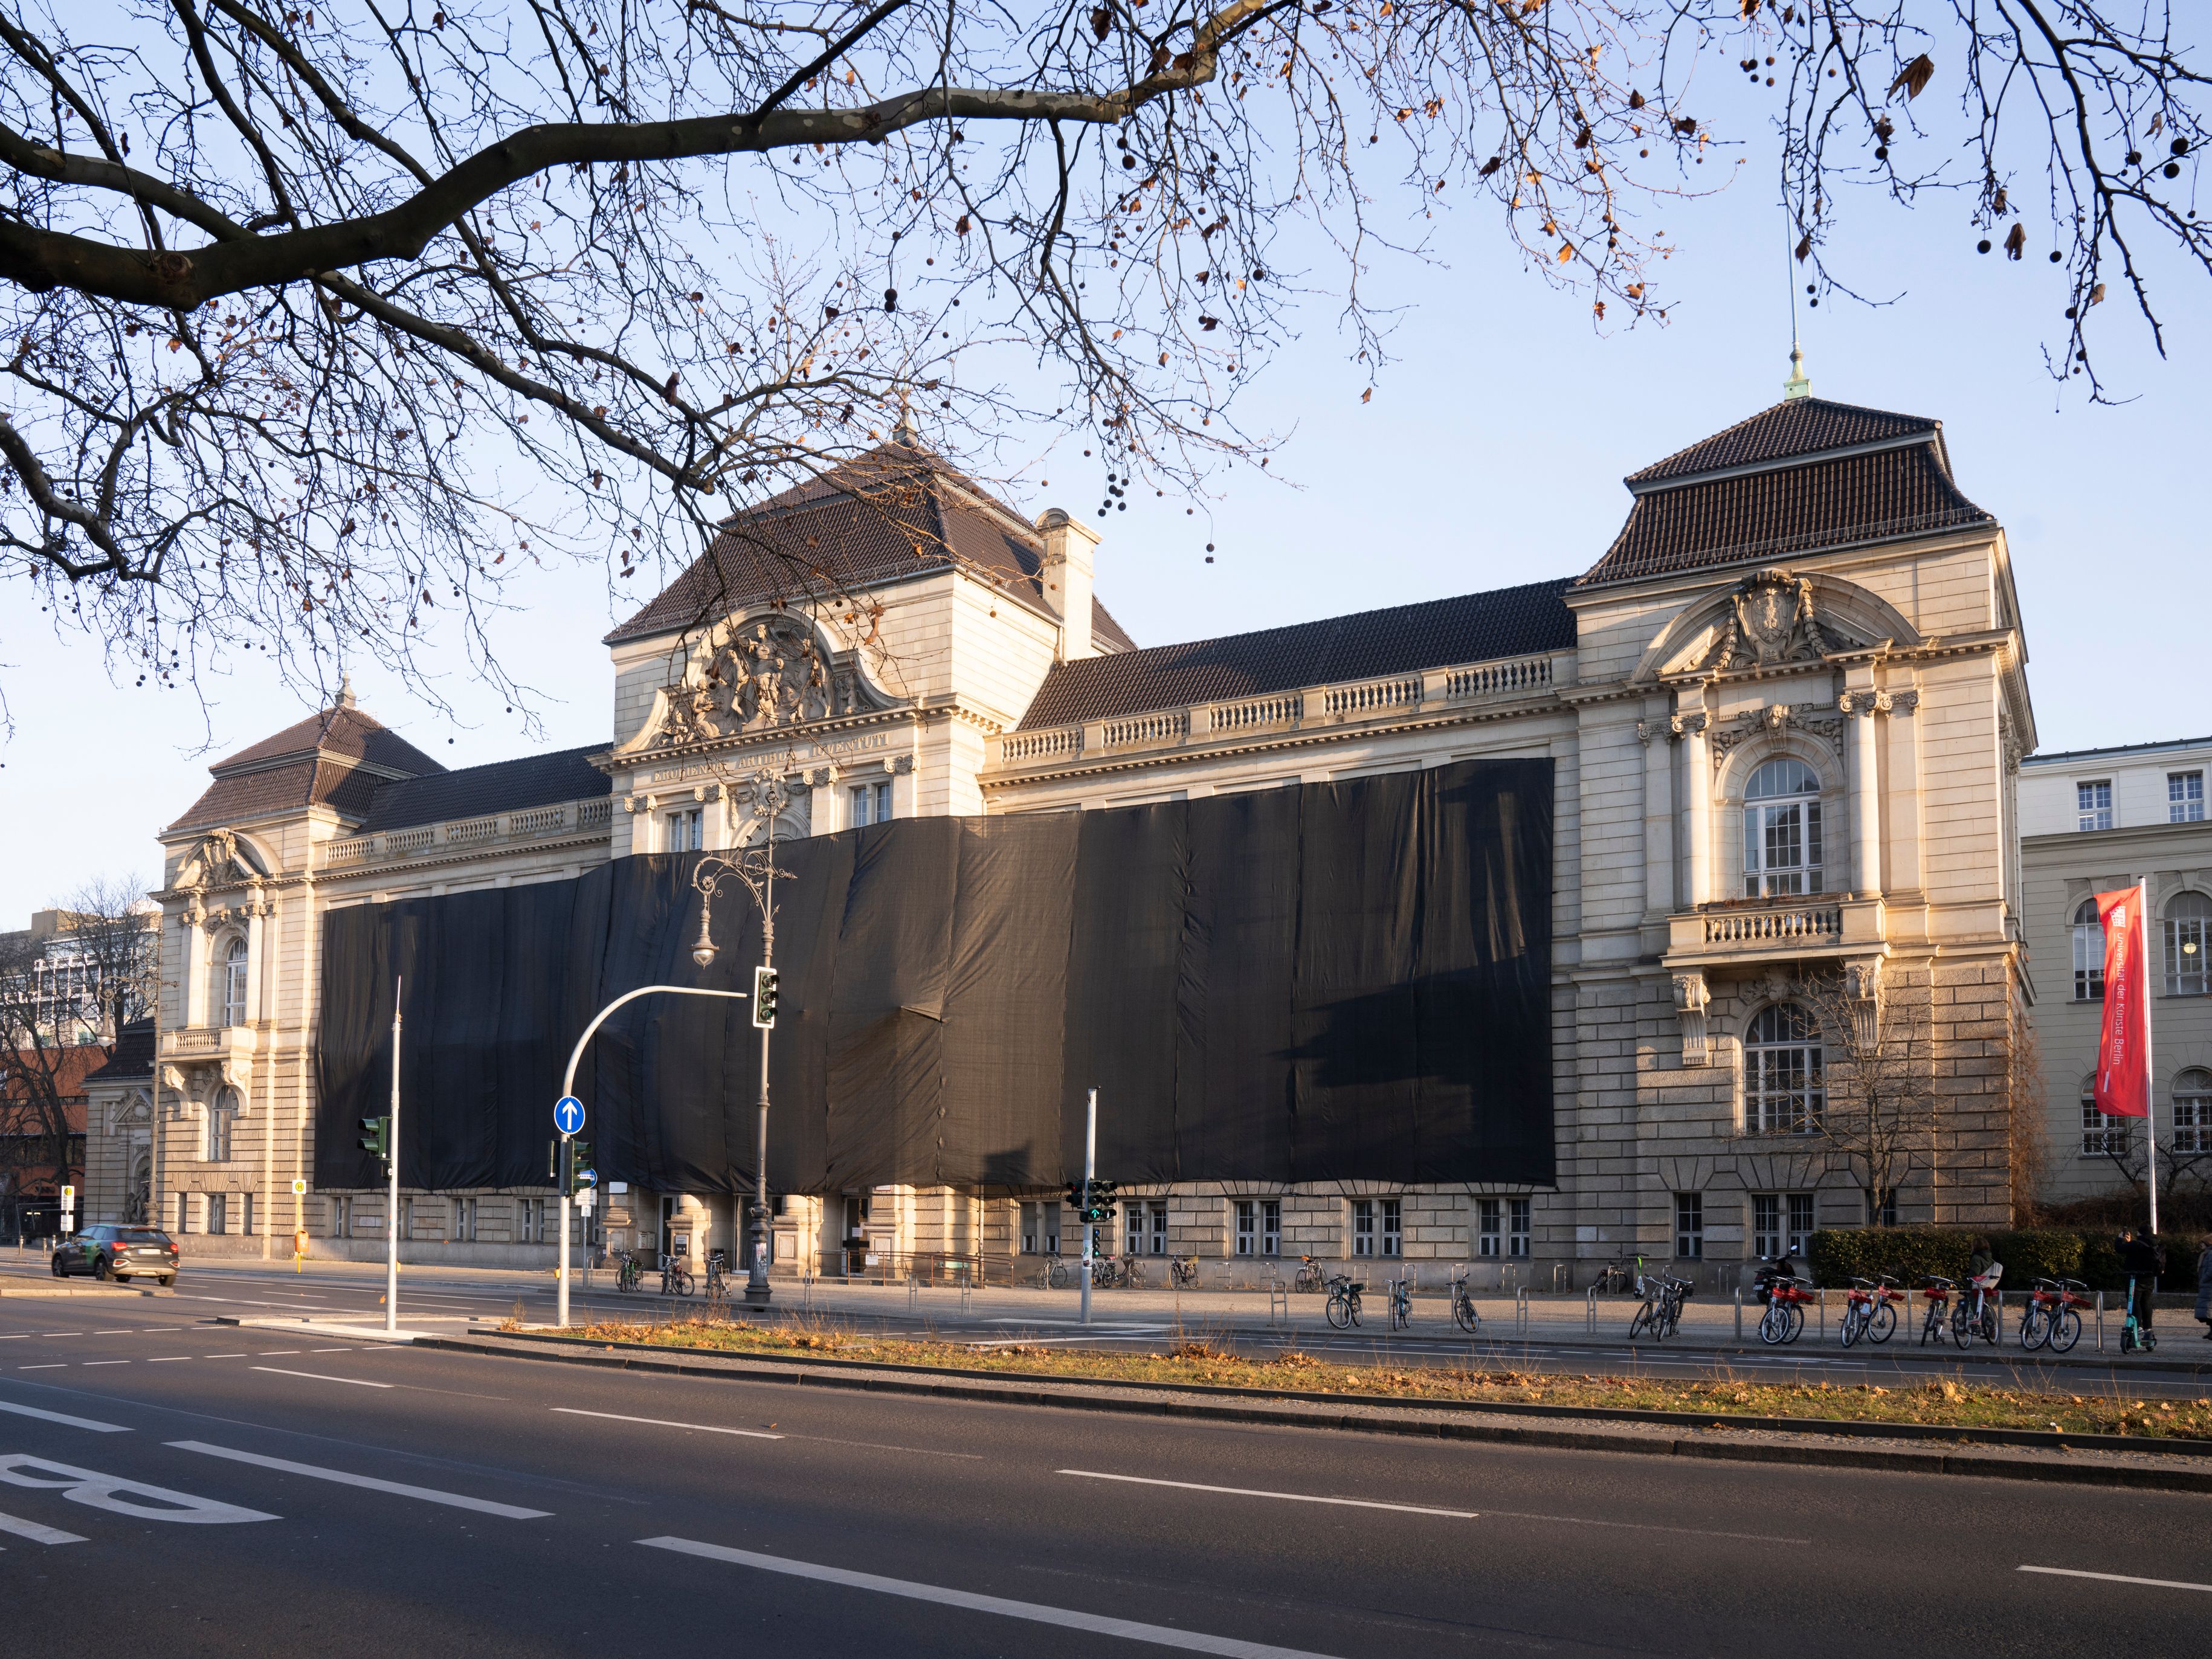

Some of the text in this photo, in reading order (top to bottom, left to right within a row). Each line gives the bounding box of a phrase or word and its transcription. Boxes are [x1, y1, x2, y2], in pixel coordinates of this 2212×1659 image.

[2113, 933, 2126, 1065] Universität der Künste Berlin
